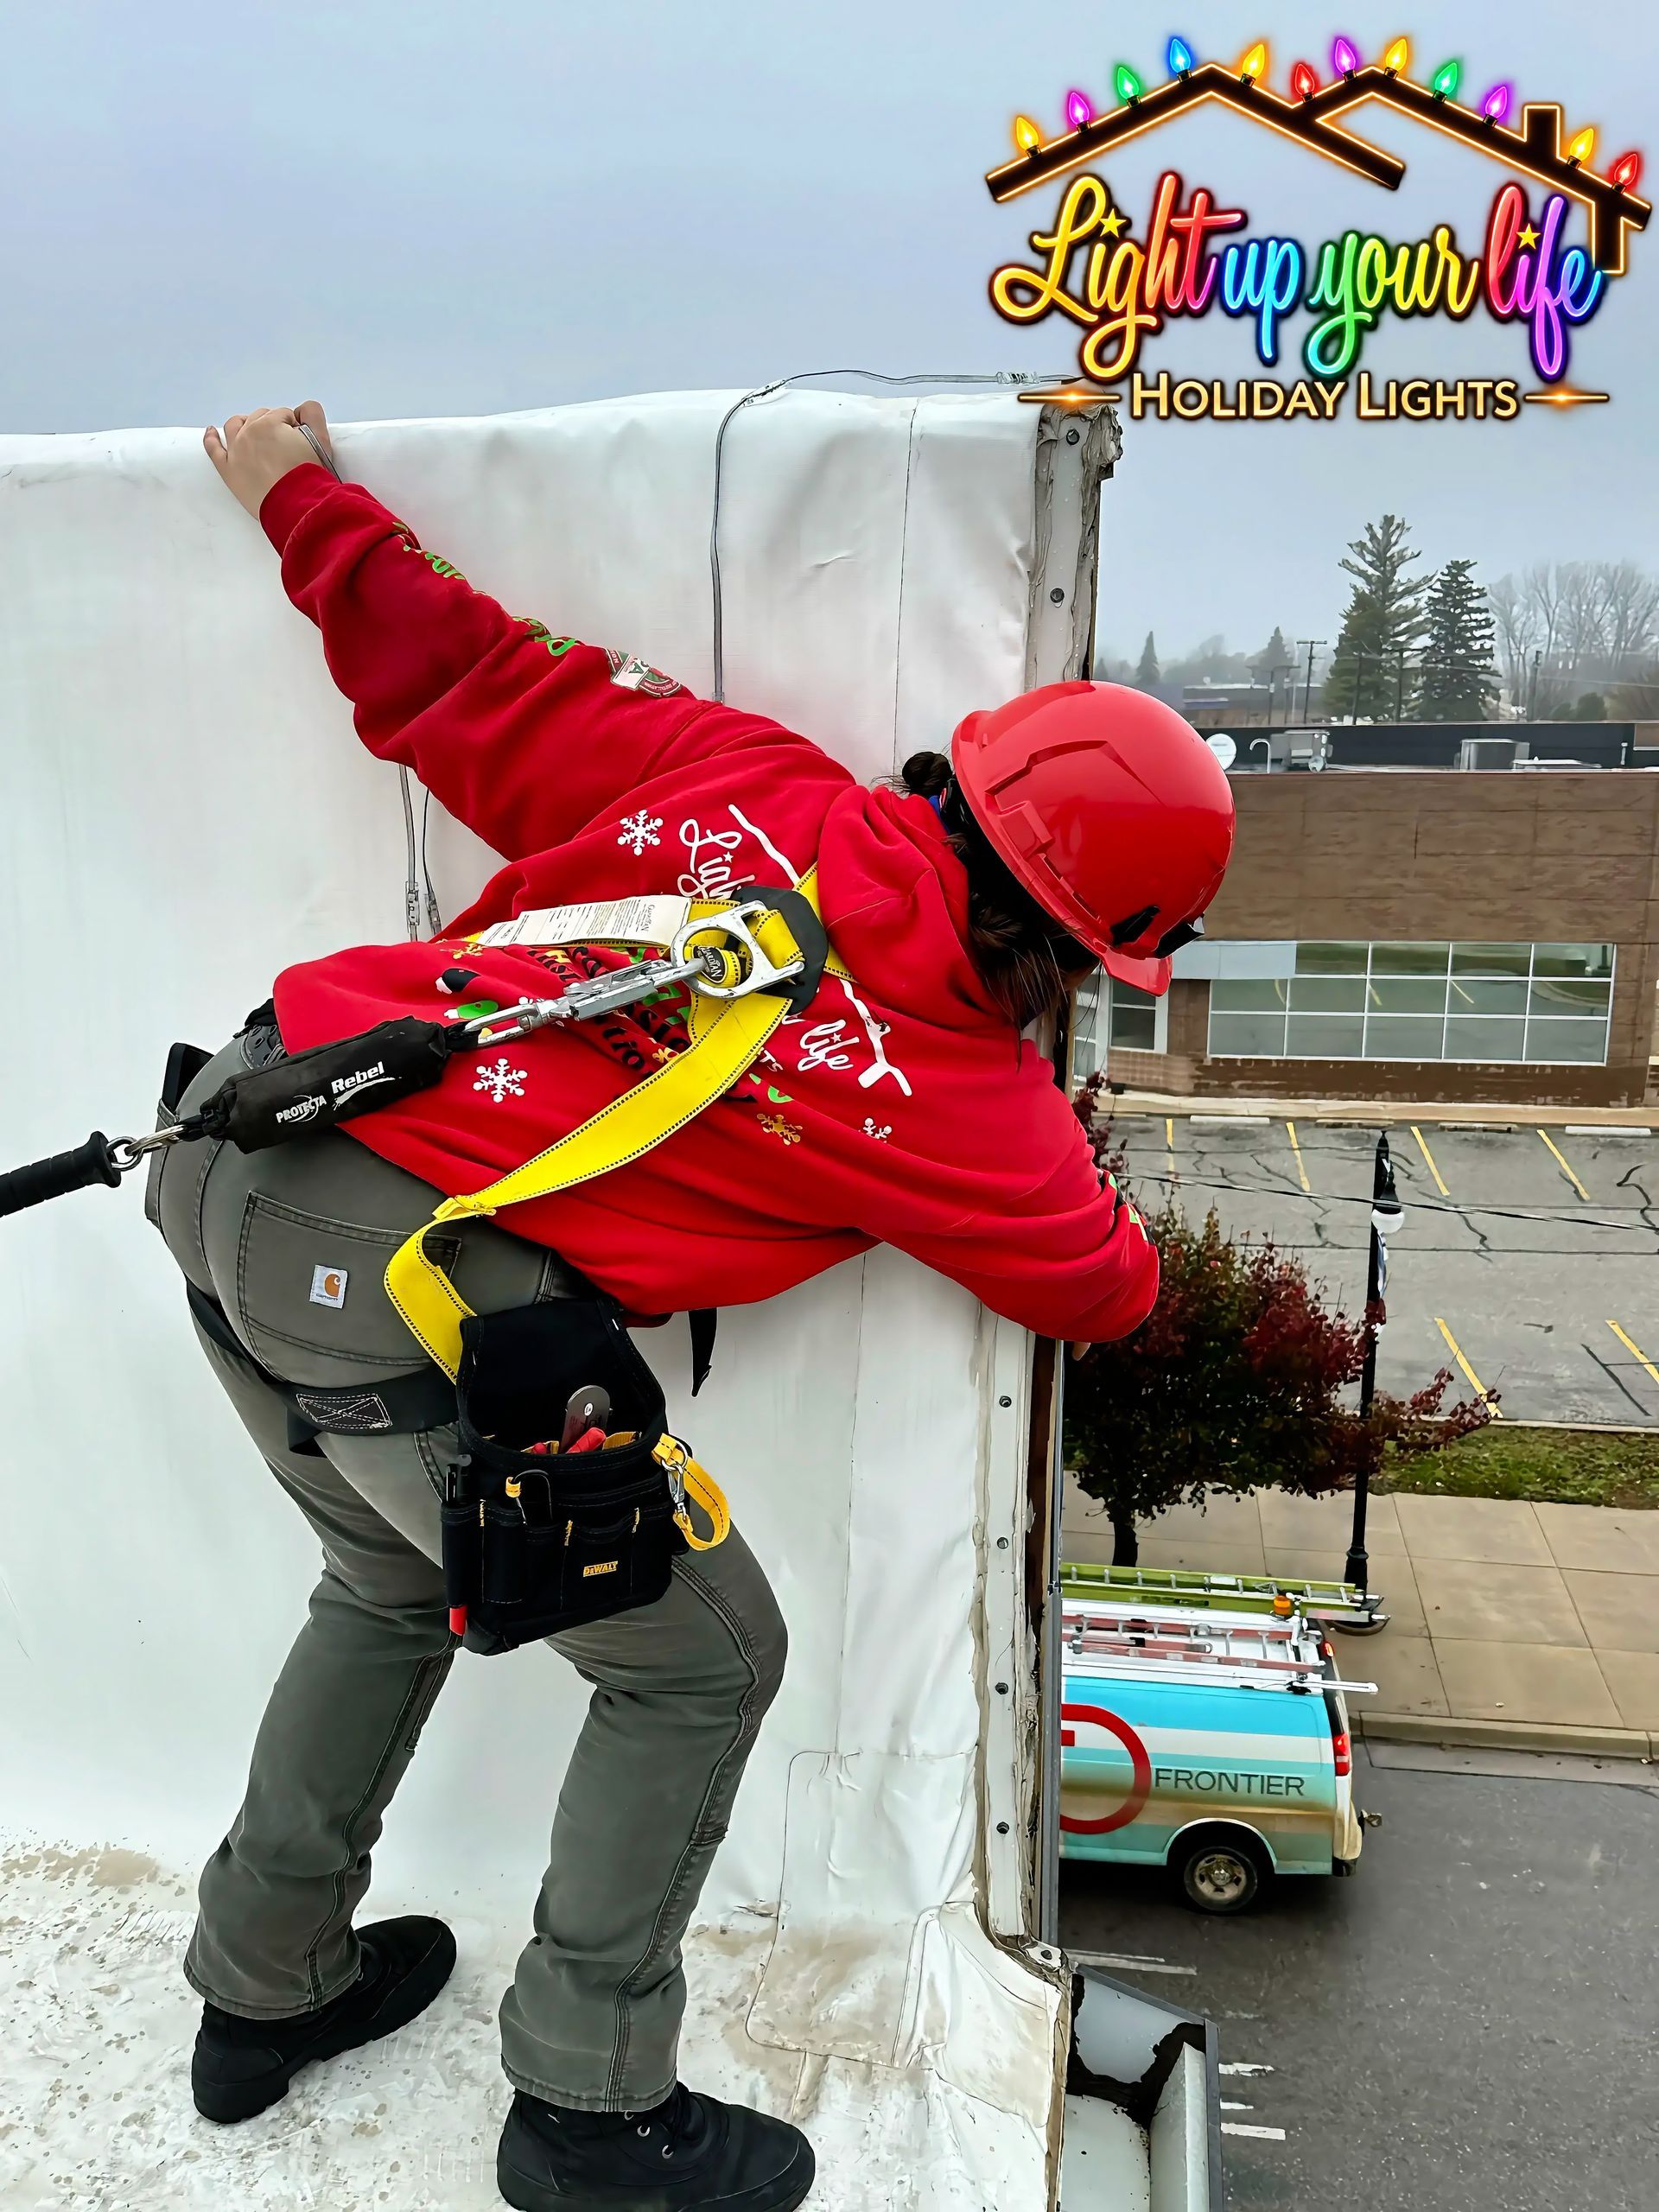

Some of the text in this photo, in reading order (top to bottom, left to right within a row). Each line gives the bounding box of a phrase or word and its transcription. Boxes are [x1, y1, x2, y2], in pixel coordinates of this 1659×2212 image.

[797, 1019, 860, 1071] life
[276, 1060, 385, 1123] PROTECTA Rebel
[1154, 1768, 1306, 1796] FRONTIER
